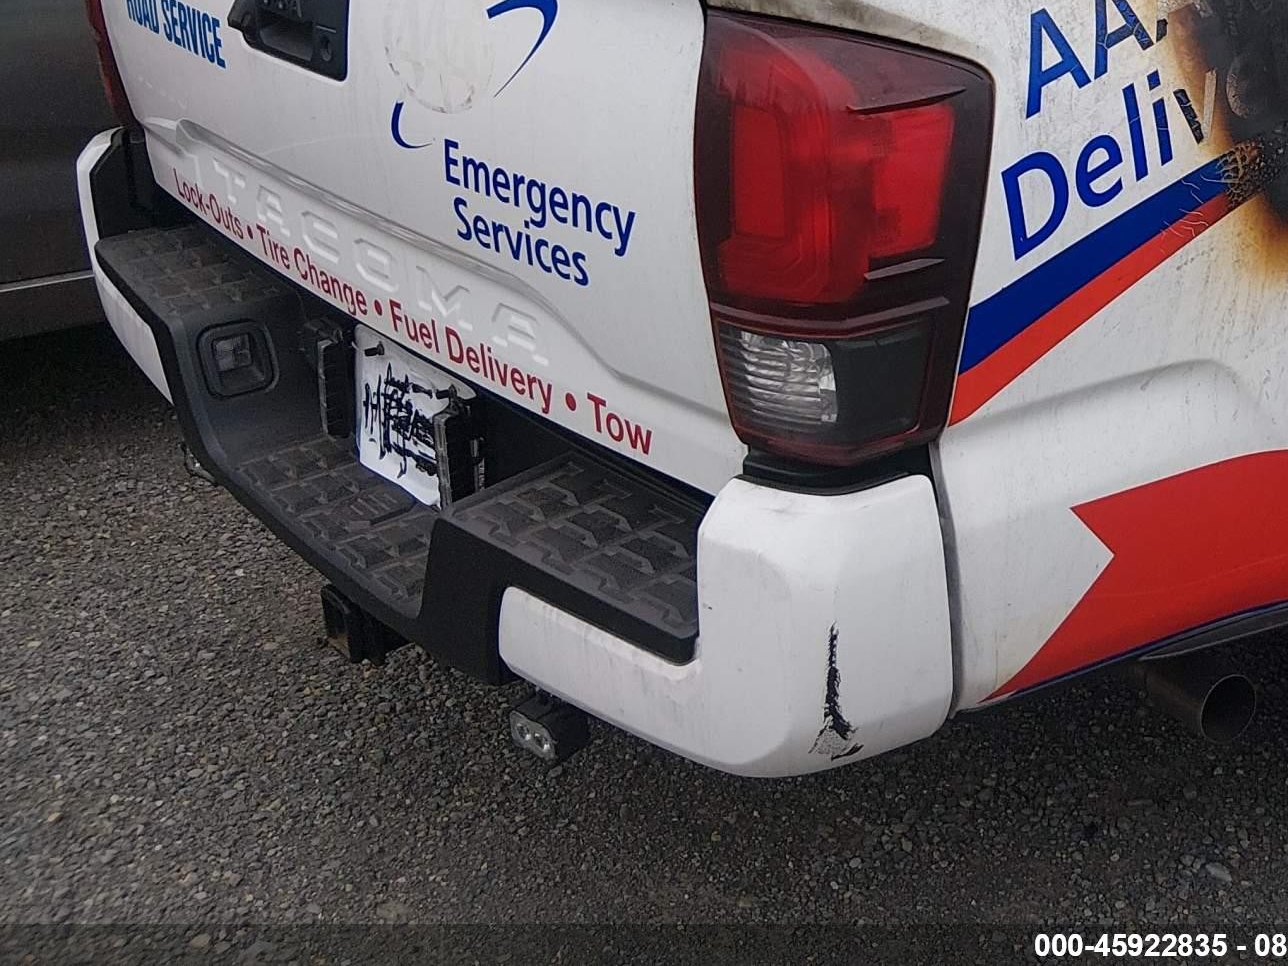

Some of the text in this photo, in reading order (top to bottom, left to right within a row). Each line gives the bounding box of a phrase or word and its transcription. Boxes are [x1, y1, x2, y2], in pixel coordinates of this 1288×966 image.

[444, 138, 636, 257] Emergency
[453, 196, 590, 286] Services
[173, 168, 653, 456] Lock-Outs Tire Change Fuel Delivery Tow
